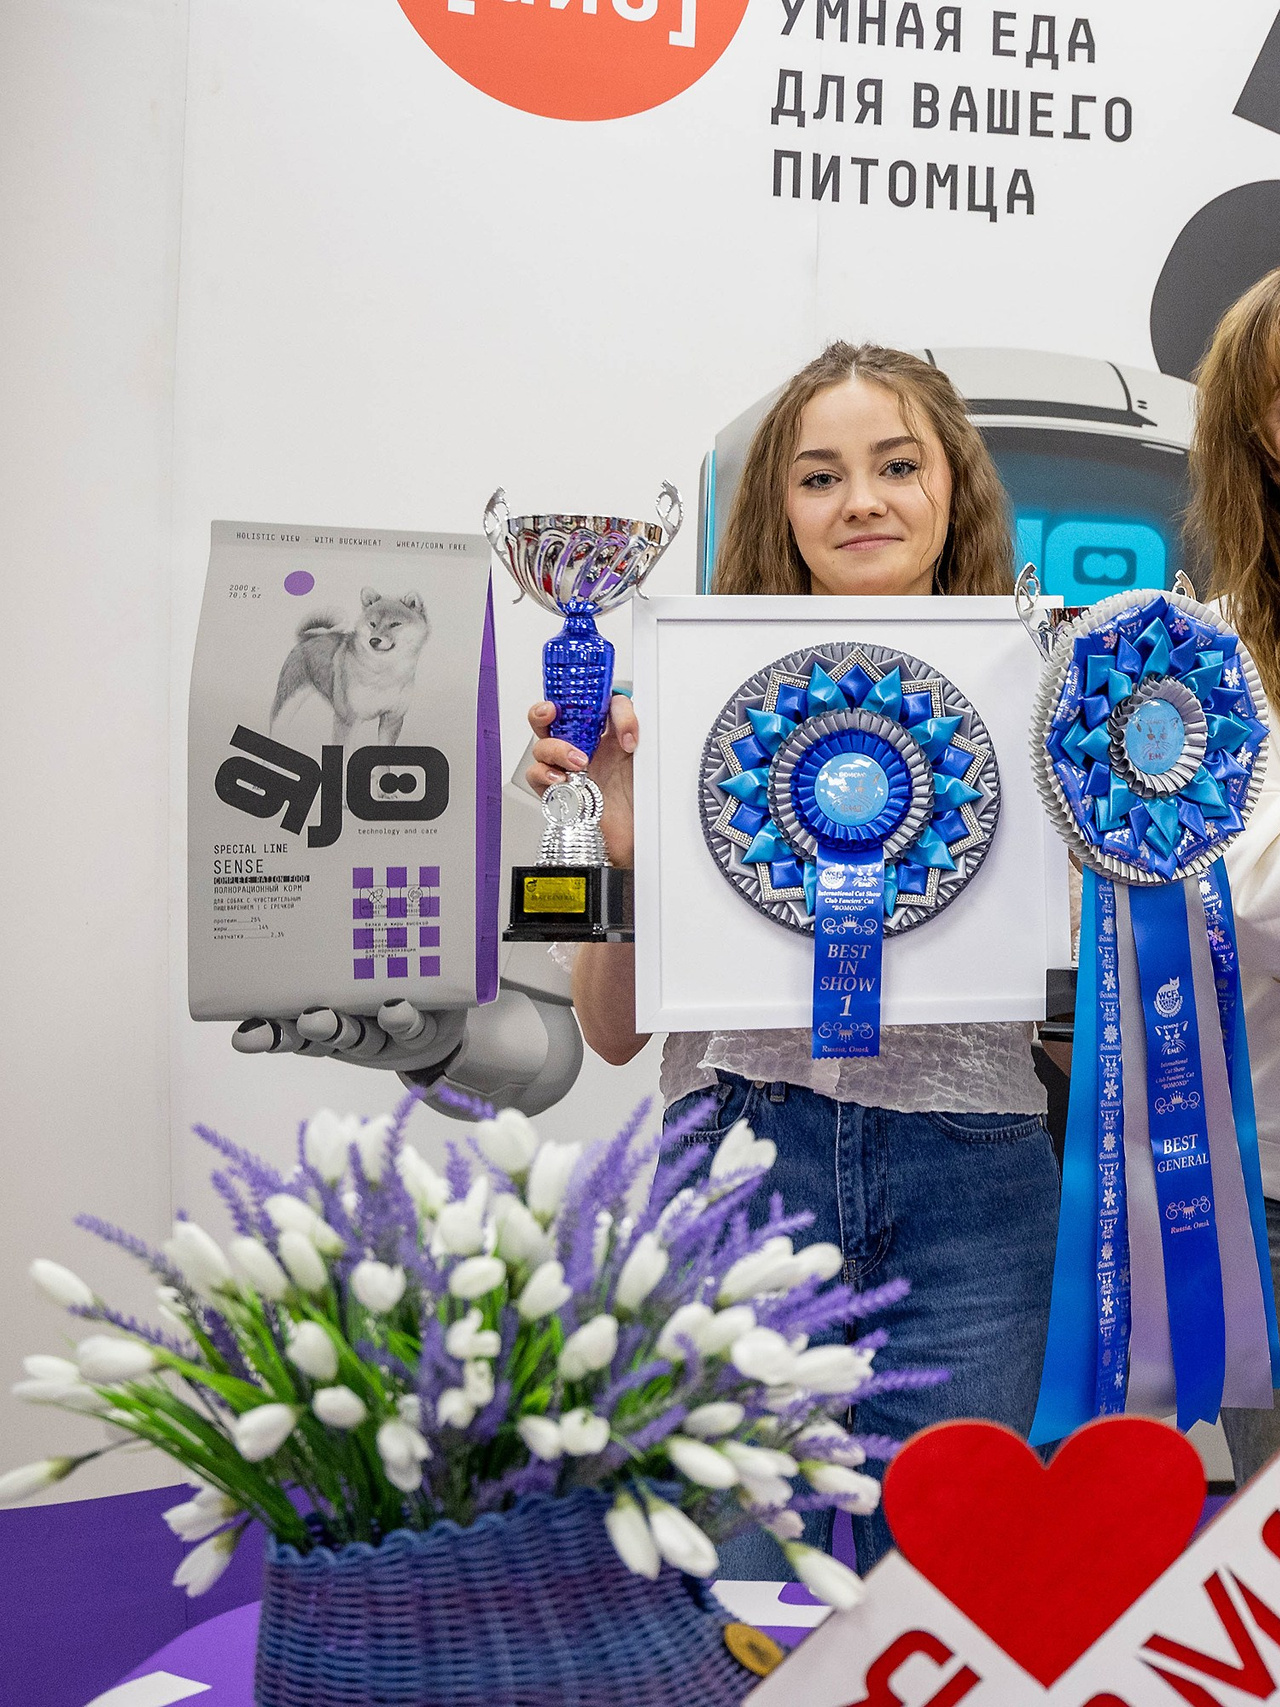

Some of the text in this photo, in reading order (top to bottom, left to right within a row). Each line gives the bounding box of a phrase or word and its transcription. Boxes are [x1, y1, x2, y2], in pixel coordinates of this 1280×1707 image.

[780, 0, 1096, 70] УМНАЯ ЕДА
[771, 68, 1133, 143] ДЛЯ ВАШЕГО
[773, 149, 1035, 223] ПИТОМЦА
[236, 532, 300, 542] HOLISTIC VIEW
[314, 536, 334, 544] WITH
[214, 843, 288, 855] SPECIAL LINE
[213, 859, 264, 875] SENSE
[214, 884, 303, 894] ПОЛНОРАЦИОННЫЙ КОРМ
[827, 943, 871, 959] BEST
[838, 961, 859, 975] IN
[820, 976, 875, 992] SHOW
[839, 994, 852, 1017] 1
[1163, 1133, 1199, 1155] BEST
[1157, 1152, 1210, 1173] GENERAL
